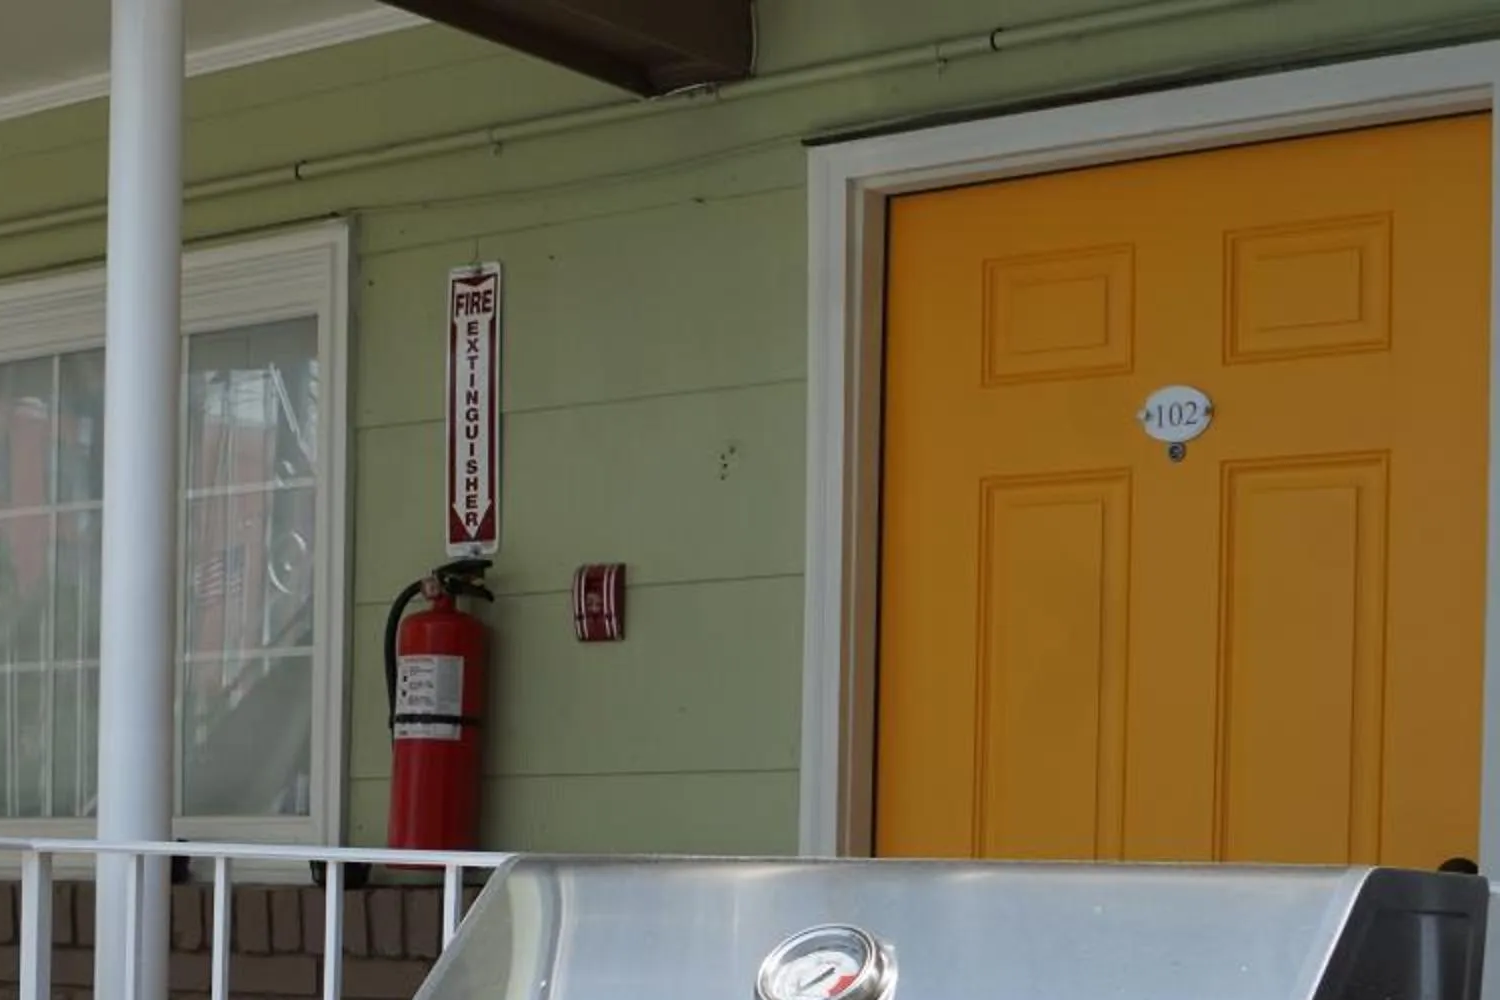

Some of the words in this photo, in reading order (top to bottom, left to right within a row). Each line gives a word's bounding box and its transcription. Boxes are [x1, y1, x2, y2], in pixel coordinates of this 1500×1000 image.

[455, 289, 493, 317] FIRE
[465, 321, 480, 526] EXTINGUISHER
[1157, 400, 1198, 428] 102
